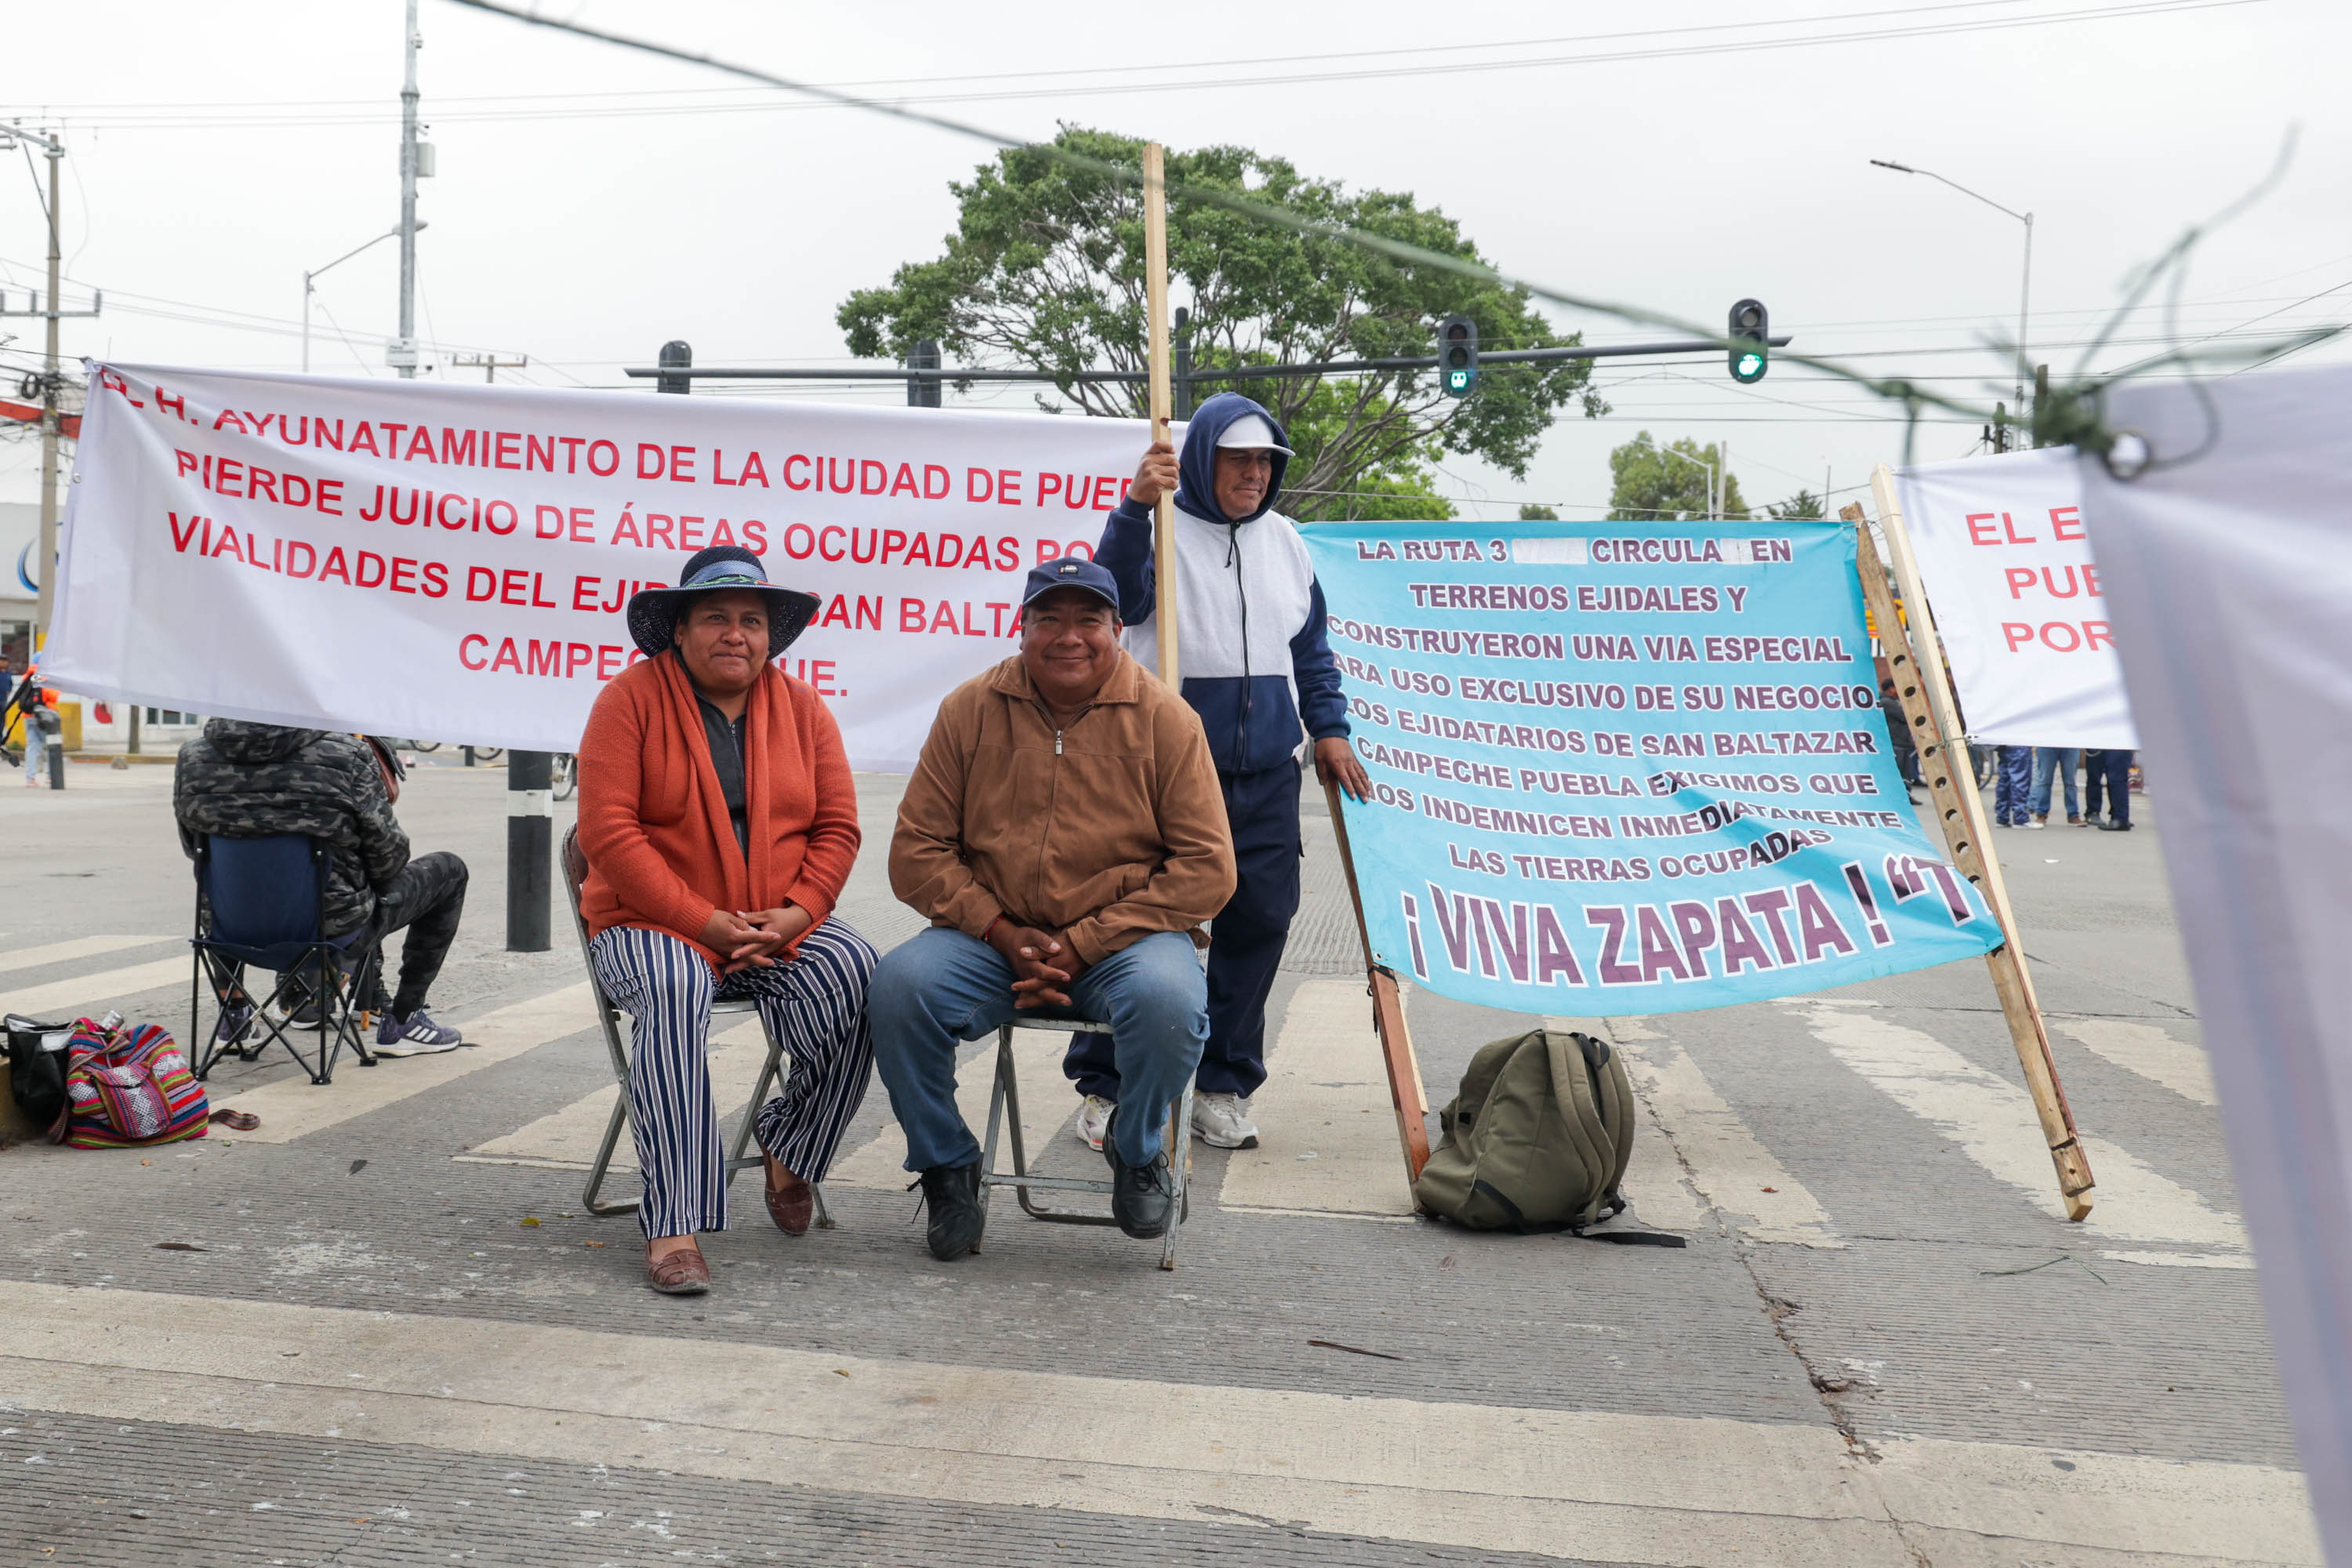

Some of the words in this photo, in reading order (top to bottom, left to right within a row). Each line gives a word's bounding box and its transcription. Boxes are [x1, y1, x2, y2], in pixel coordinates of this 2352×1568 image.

[154, 385, 199, 426] H.
[212, 408, 620, 477] AYUNATAMIENTO
[637, 443, 696, 483] DE
[713, 448, 770, 488] LA
[783, 454, 950, 499] CIUDAD
[967, 467, 1022, 506] DE
[175, 448, 344, 517] PIERDE
[359, 484, 518, 536] JUICIO
[535, 505, 595, 543] DE
[610, 502, 768, 557] ÁREAS
[783, 522, 1019, 572] OCUPADAS
[1965, 512, 2037, 546] EL
[168, 512, 449, 598] VIALIDADES
[466, 565, 557, 609] DEL
[572, 575, 669, 614] EJI
[1356, 540, 1396, 561] LA
[1403, 540, 1483, 561] RUTA
[1490, 540, 1507, 561] 3
[1592, 539, 1723, 562] CIRCULA
[1750, 539, 1792, 562] EN
[1410, 584, 1568, 610] TERRENOS
[1577, 586, 1718, 612] EJIDALES
[1726, 587, 1747, 612] Y
[1327, 615, 1563, 660] CONSTRUYERON
[1573, 636, 1638, 660] UNA
[1644, 637, 1697, 662] VIA
[1705, 637, 1852, 662] ESPECIAL
[2001, 619, 2118, 653] POR
[1391, 668, 1450, 697] USO
[1460, 677, 1625, 710] EXCLUSIVO
[1635, 686, 1675, 710] DE
[1683, 686, 1723, 710] SU
[1397, 709, 1585, 753] EJIDATARIOS
[1594, 732, 1633, 757] DE
[1642, 734, 1704, 757] SAN
[1714, 732, 1878, 757] BALTAZAR
[1356, 735, 1512, 790] CAMPECHE
[1520, 770, 1642, 797] PUEBLA
[1647, 771, 1800, 797] EXIGIMOS
[1809, 774, 1878, 796] QUE
[1423, 795, 1612, 838] INDEMNICEN
[1621, 800, 1903, 837] INMEDIATAMENTE
[1449, 844, 1505, 876] LAS
[1513, 855, 1650, 880] TIERRAS
[1660, 829, 1832, 878] OCUPADAS
